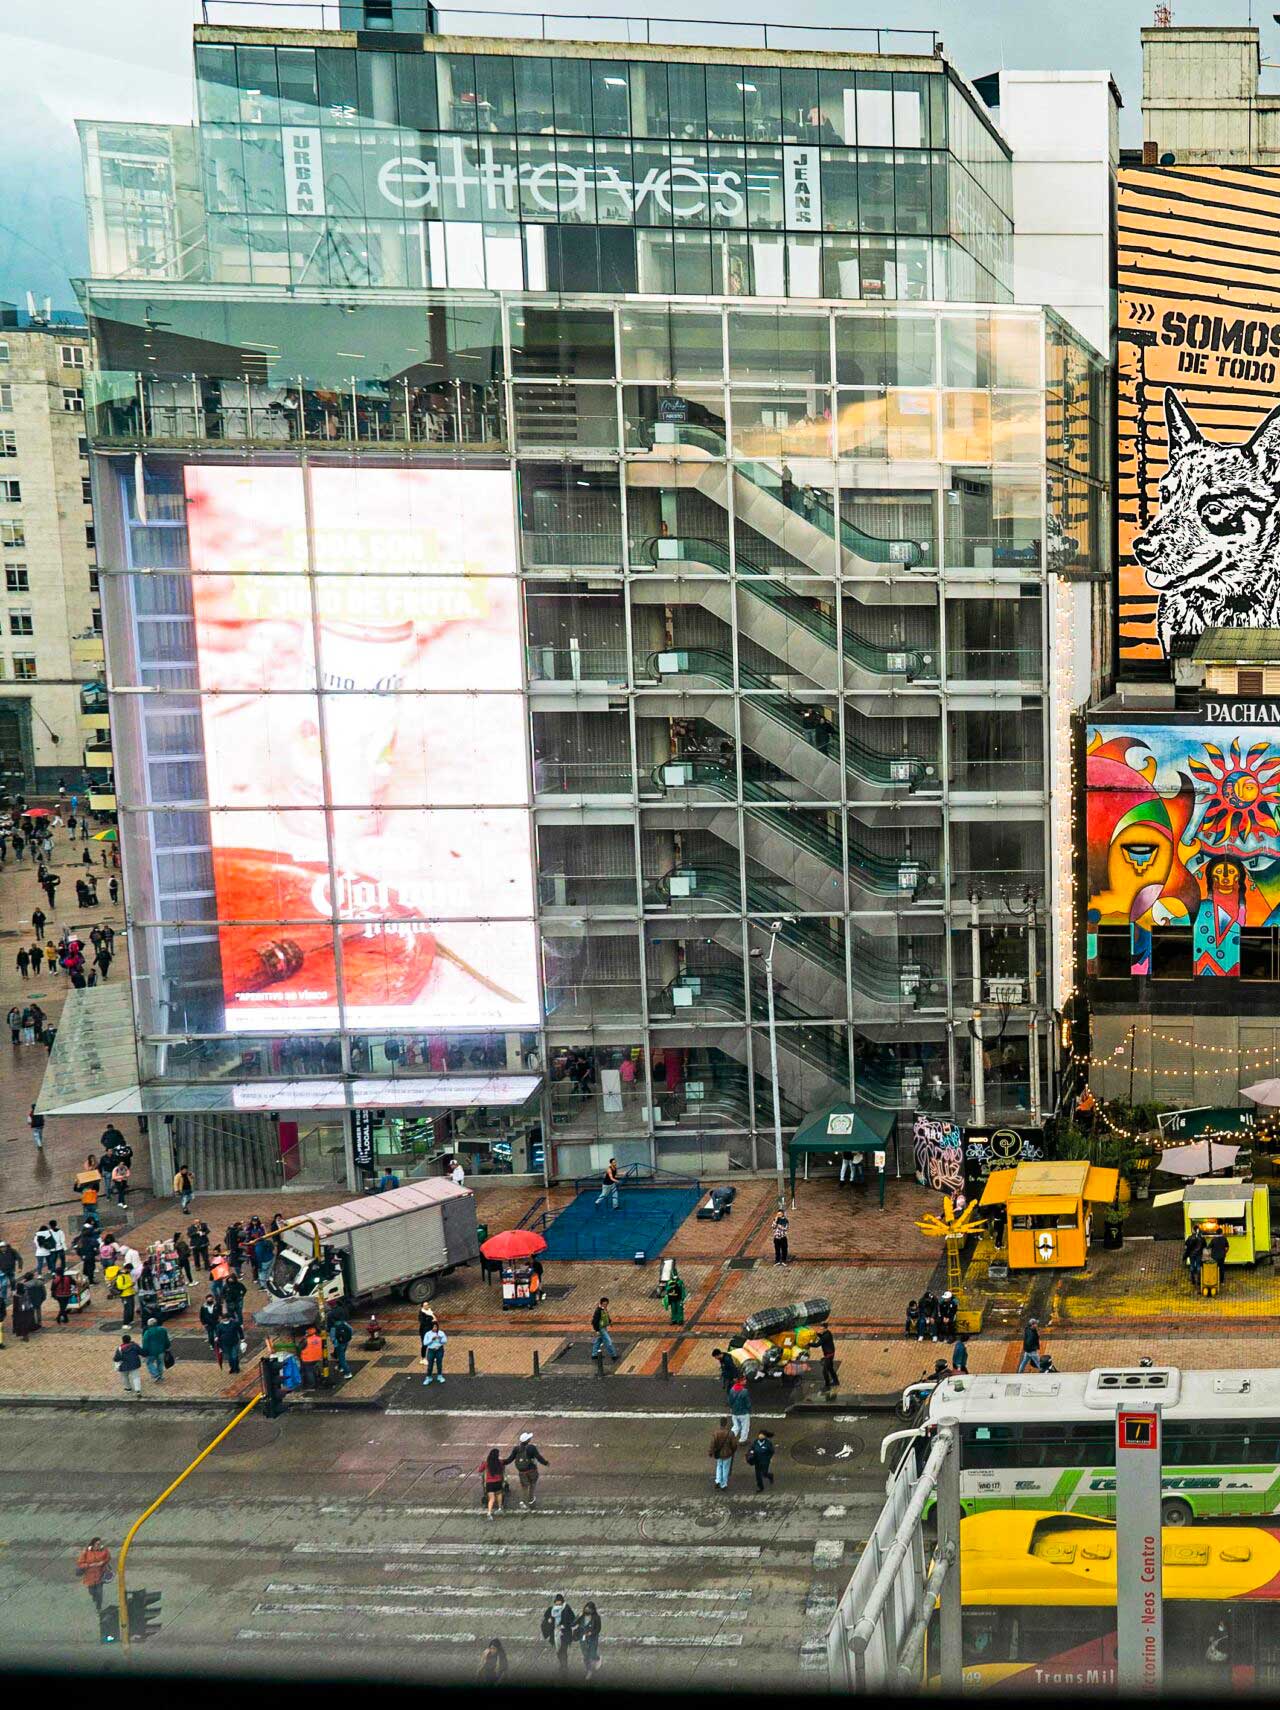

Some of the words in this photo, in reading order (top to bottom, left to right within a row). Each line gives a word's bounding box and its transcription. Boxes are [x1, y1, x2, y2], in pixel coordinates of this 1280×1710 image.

[292, 135, 314, 212] URBAN
[793, 153, 811, 223] JEANS
[1178, 351, 1210, 375] DE
[1216, 355, 1276, 384] TODO
[271, 589, 342, 615] JUO
[1140, 1536, 1155, 1582] Centro
[1141, 1591, 1155, 1624] Neos
